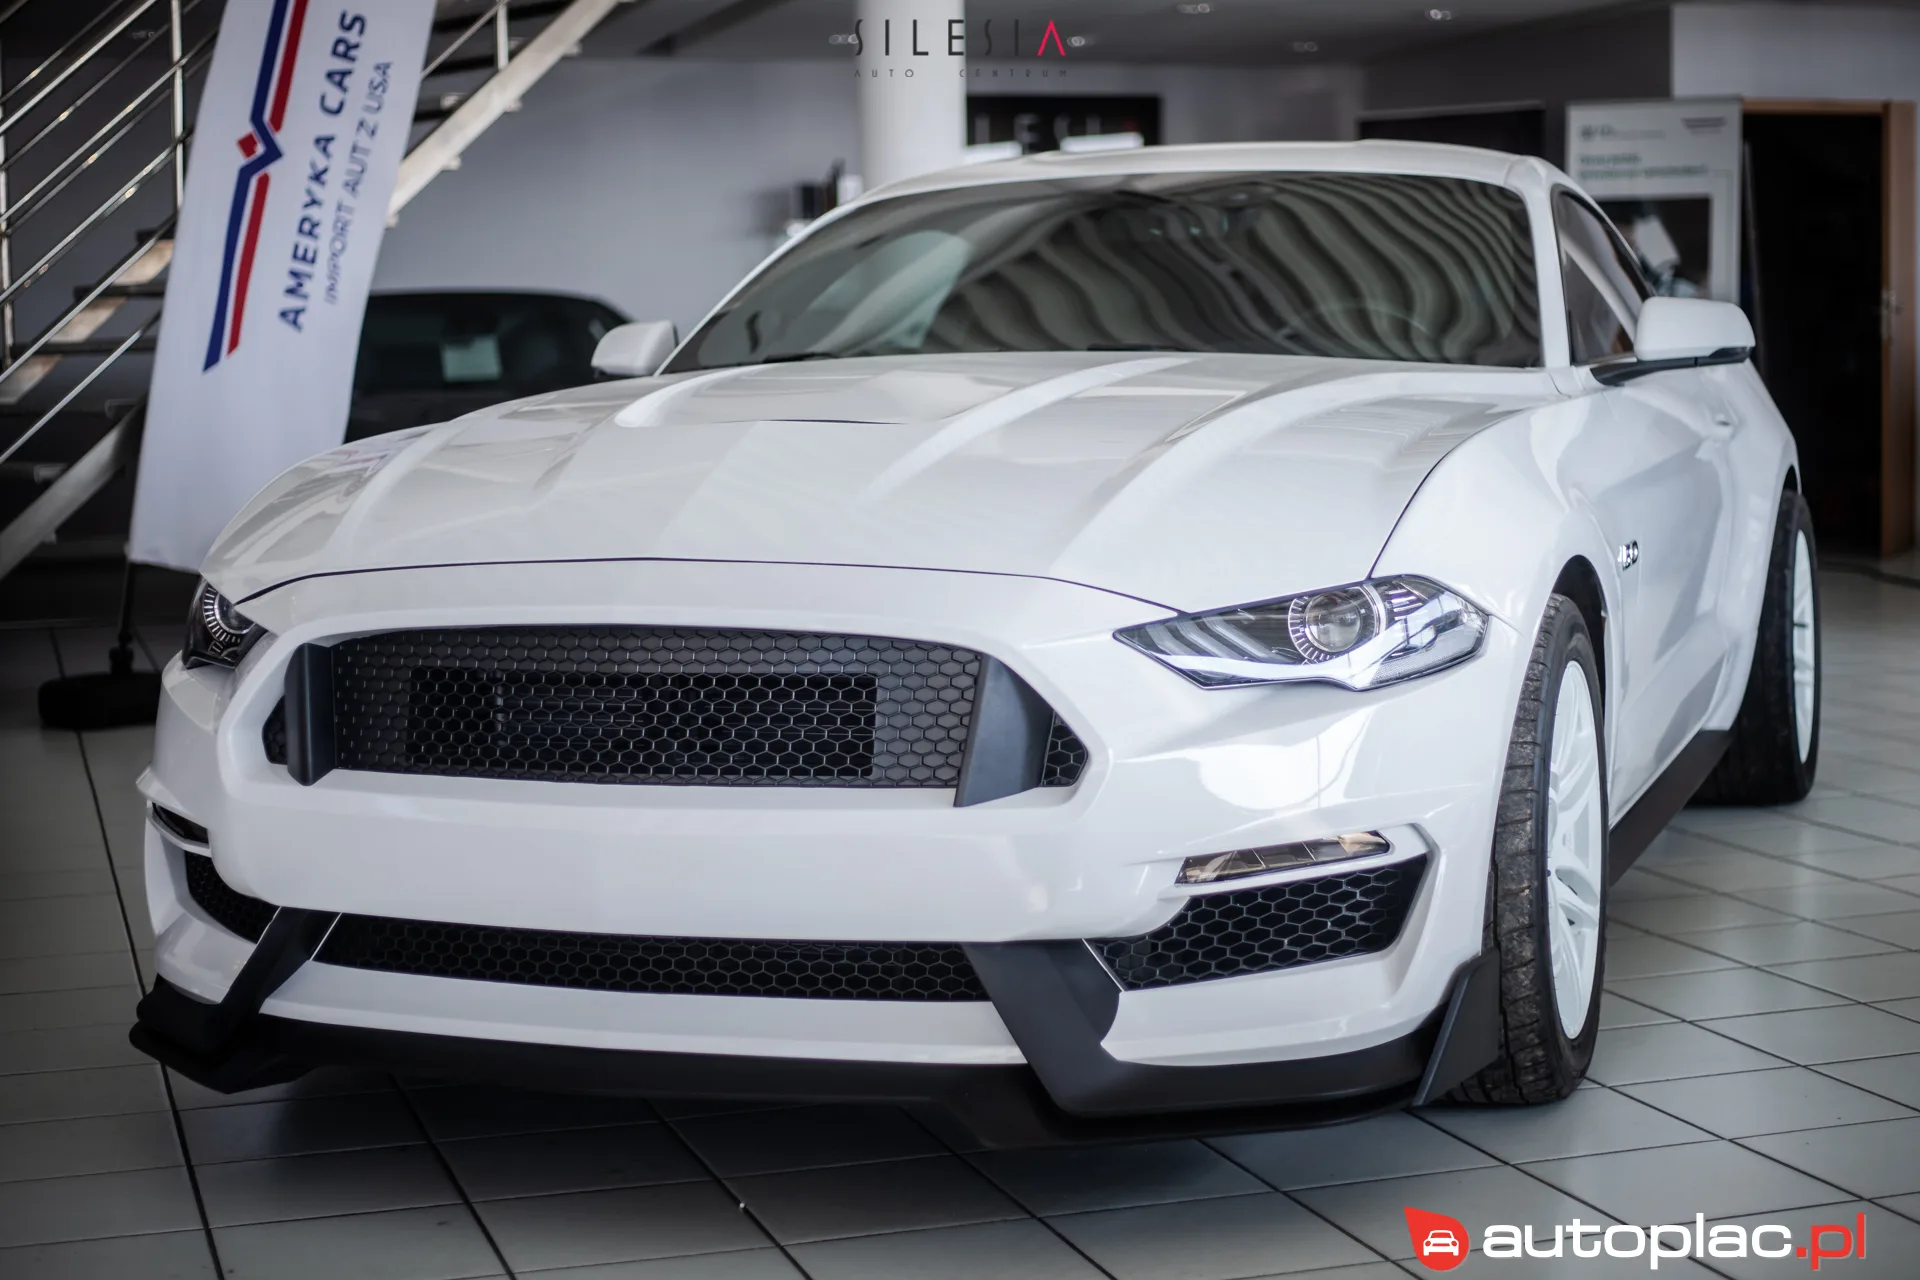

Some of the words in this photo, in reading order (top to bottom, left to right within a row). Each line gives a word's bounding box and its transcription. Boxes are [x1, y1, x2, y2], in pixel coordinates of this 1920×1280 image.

[362, 60, 393, 117] USA
[356, 119, 378, 141] Z
[278, 133, 336, 333] AMERYKA
[319, 10, 367, 117] CARS
[342, 139, 370, 199] AUT
[324, 200, 356, 305] IMPORT
